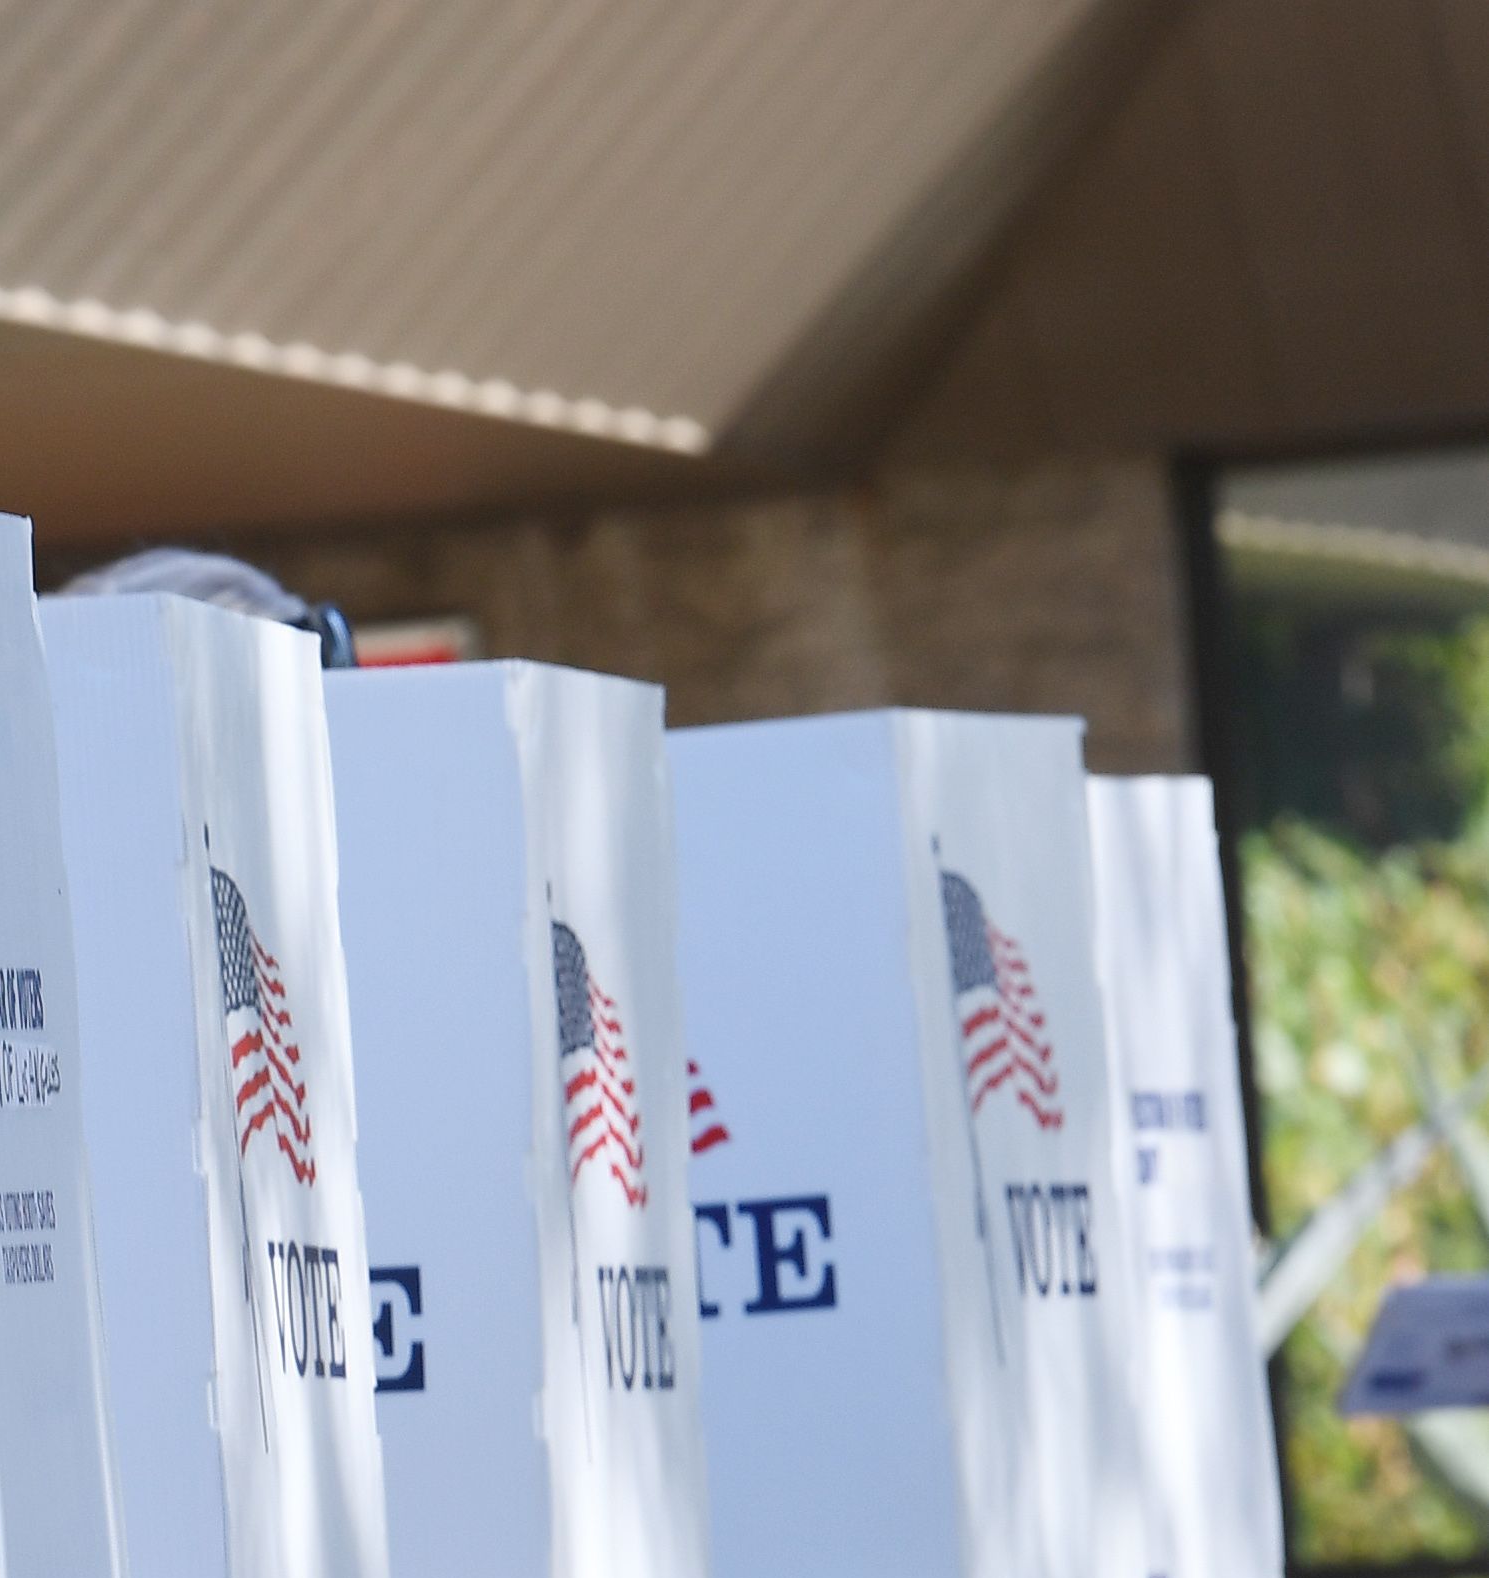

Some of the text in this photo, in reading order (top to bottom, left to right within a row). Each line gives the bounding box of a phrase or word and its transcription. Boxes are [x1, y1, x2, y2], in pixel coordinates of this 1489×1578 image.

[1007, 1182, 1097, 1298] VOTE
[268, 1239, 347, 1380] VOTE
[597, 1265, 676, 1393] VOTE
